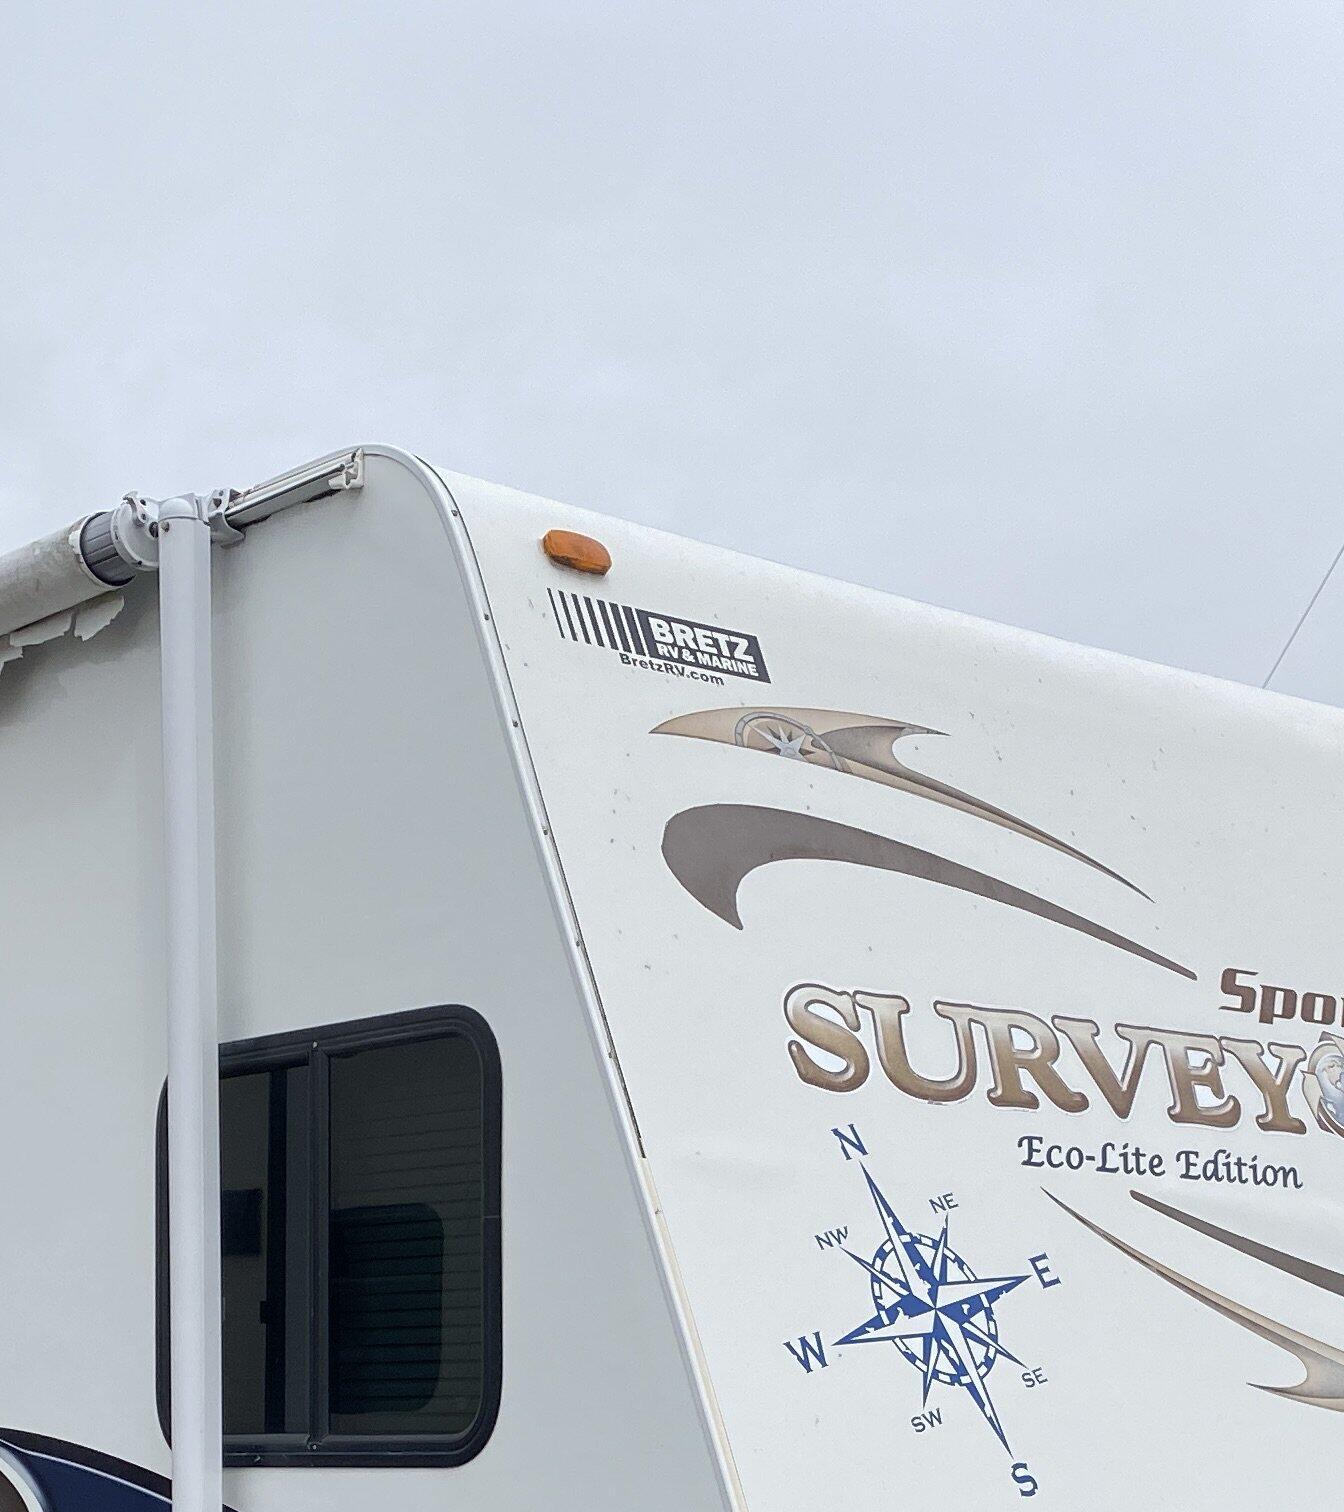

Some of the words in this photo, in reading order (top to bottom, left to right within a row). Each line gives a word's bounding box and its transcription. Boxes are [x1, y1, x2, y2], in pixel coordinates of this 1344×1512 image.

[647, 616, 756, 663] BRETZ
[619, 652, 725, 686] BretzRV.com
[656, 645, 679, 660] RV
[681, 650, 696, 664] &
[697, 652, 760, 677] MARINE
[830, 1123, 870, 1161] N
[1017, 1134, 1164, 1178] Eco-Lite
[1174, 1149, 1304, 1191] Edition
[928, 1192, 960, 1214] NE
[814, 1225, 849, 1251] NW
[1027, 1252, 1062, 1290] E
[782, 1331, 830, 1374] W
[1020, 1366, 1049, 1389] SE
[909, 1407, 944, 1433] SW
[1010, 1461, 1039, 1498] S
